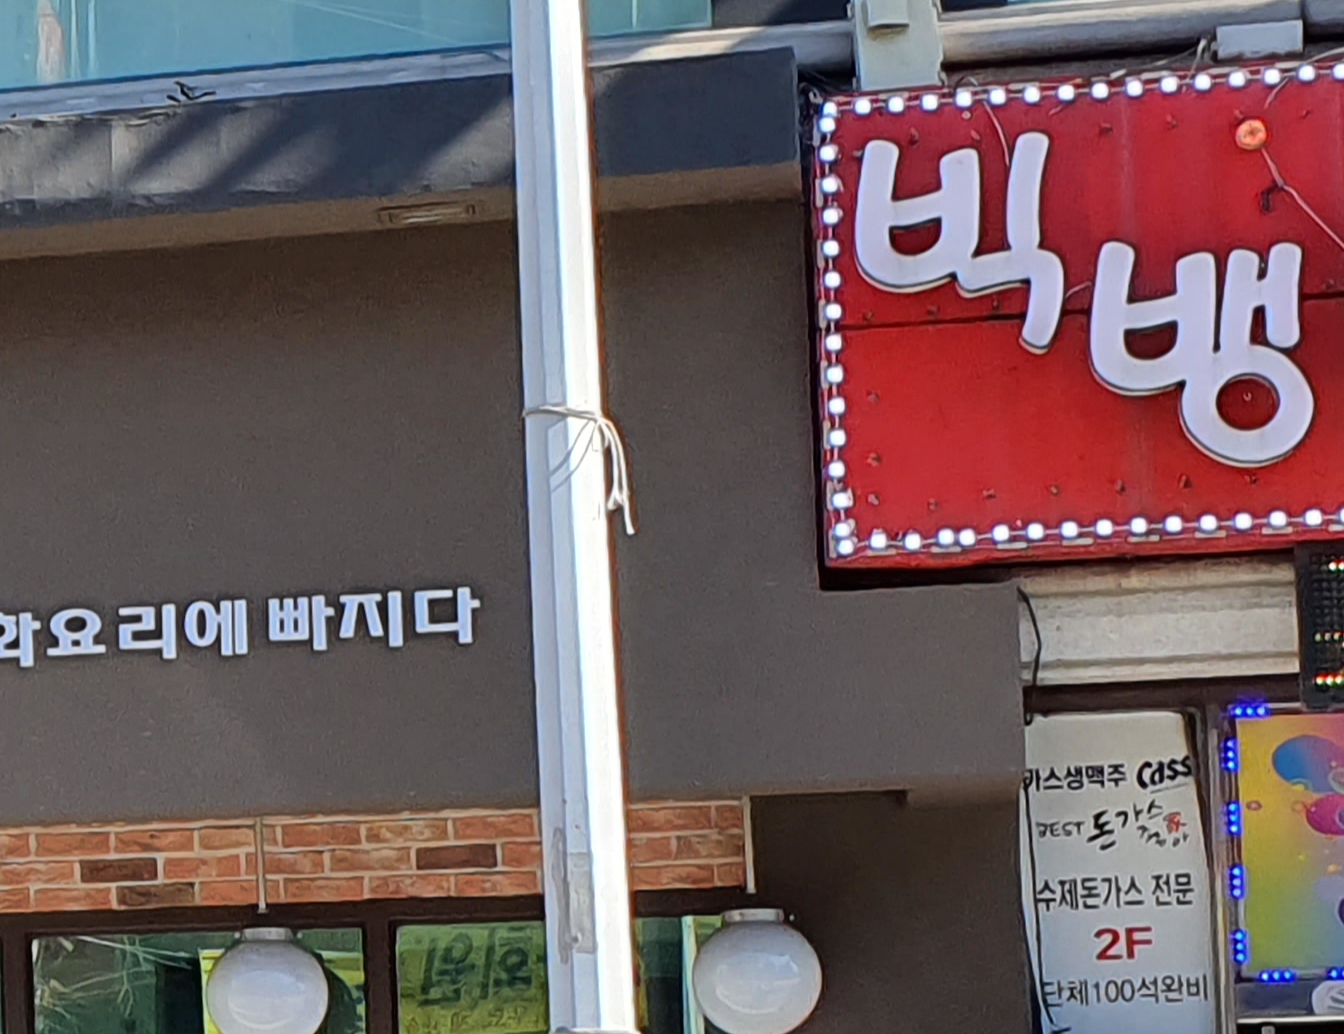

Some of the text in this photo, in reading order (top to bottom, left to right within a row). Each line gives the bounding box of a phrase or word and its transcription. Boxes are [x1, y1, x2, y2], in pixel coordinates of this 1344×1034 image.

[854, 130, 1316, 468] 빅뱅
[267, 586, 481, 652] 빠지다
[1037, 872, 1195, 912] 수제돈가스 전문
[1093, 925, 1153, 961] 2F
[1043, 972, 1209, 1008] 단체100석완비
